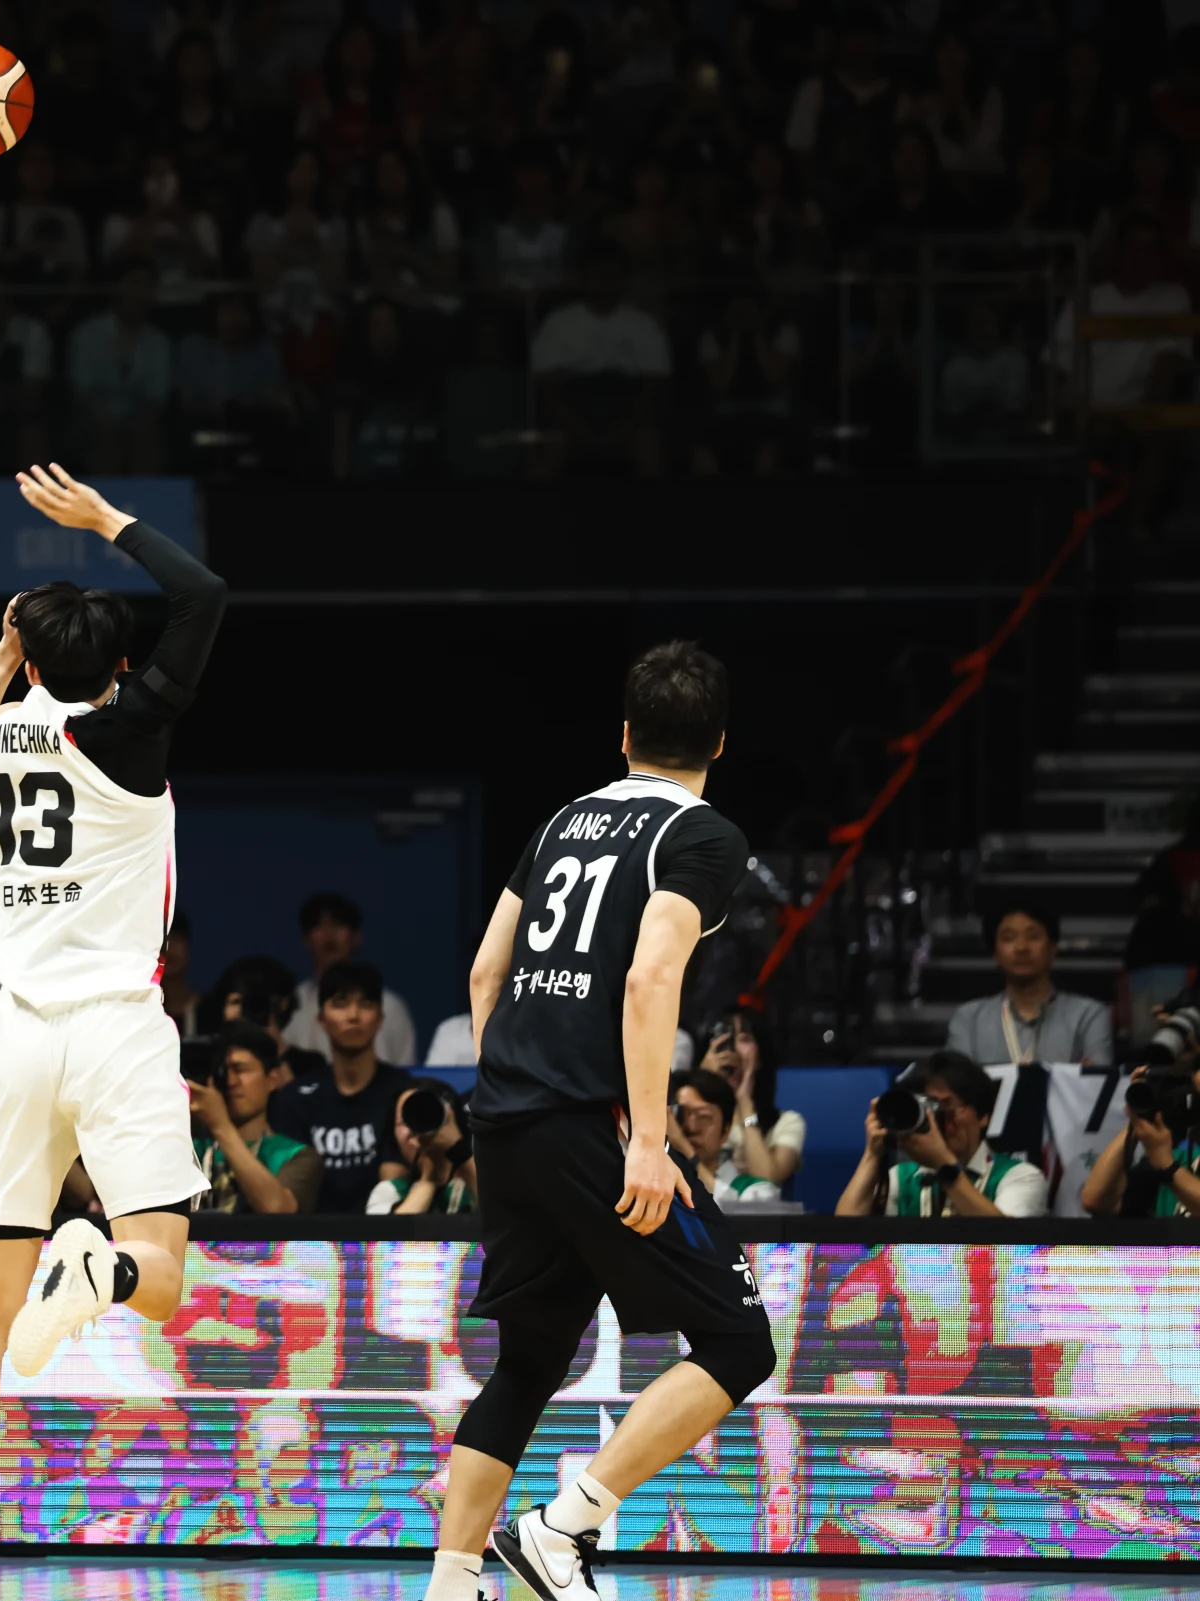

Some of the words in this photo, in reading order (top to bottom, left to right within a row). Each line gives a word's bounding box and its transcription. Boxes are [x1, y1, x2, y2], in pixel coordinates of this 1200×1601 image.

[559, 812, 612, 841] JANG
[610, 812, 633, 838] J
[628, 812, 651, 839] S
[3, 881, 83, 908] 日本生命
[527, 854, 619, 953] 31
